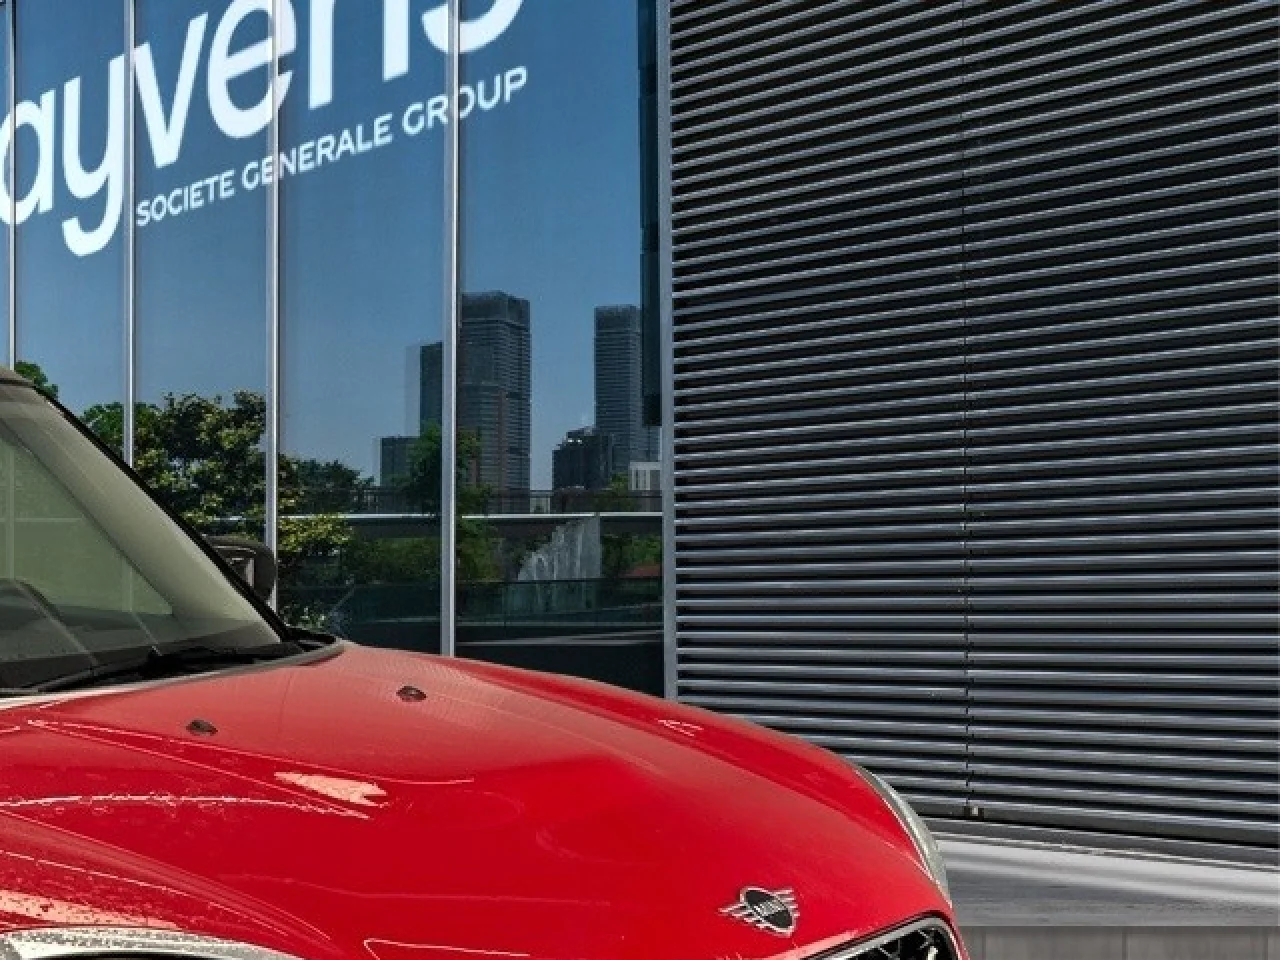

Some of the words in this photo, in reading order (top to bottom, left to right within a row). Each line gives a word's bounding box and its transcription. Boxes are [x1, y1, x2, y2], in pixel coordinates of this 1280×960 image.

[136, 170, 235, 227] SOCIETE
[241, 113, 394, 190] GENERALE
[402, 66, 527, 138] GROUP
